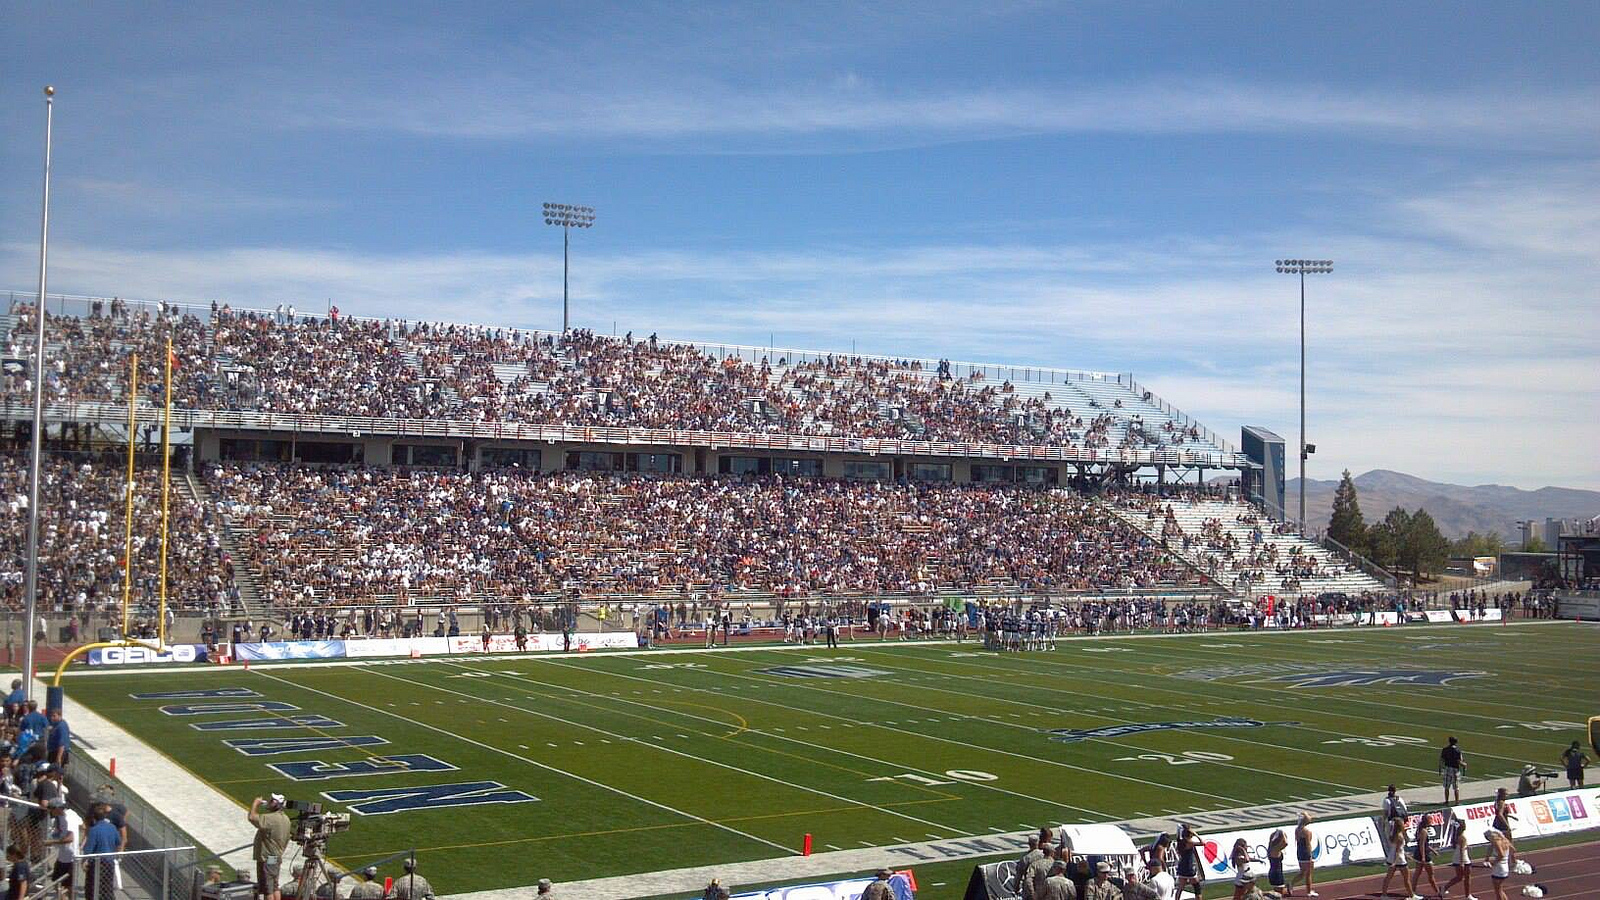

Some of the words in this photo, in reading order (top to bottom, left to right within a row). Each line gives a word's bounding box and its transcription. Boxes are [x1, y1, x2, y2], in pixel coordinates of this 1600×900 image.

[101, 644, 196, 665] GEICO
[1340, 734, 1429, 747] 30
[1138, 751, 1235, 765] 20
[893, 769, 998, 786] 10
[1325, 826, 1374, 855] pepsi
